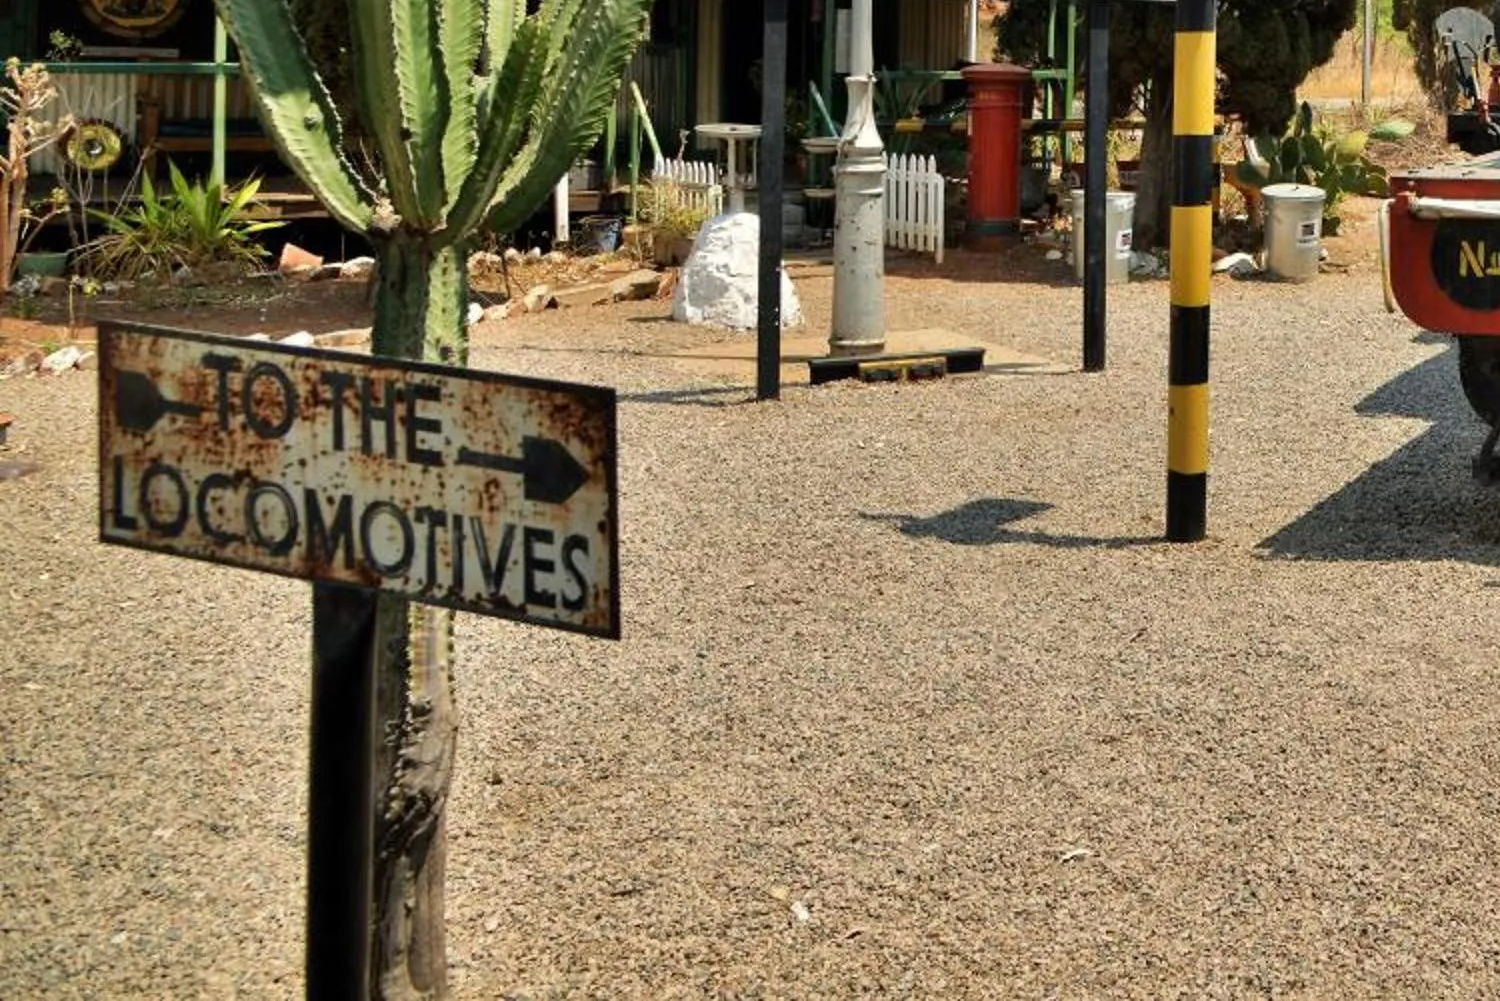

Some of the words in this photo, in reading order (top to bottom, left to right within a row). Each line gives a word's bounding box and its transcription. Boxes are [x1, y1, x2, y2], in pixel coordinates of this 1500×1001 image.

[203, 352, 295, 439] TO
[320, 369, 447, 467] THE
[112, 455, 591, 612] LOCOMOTIVES
